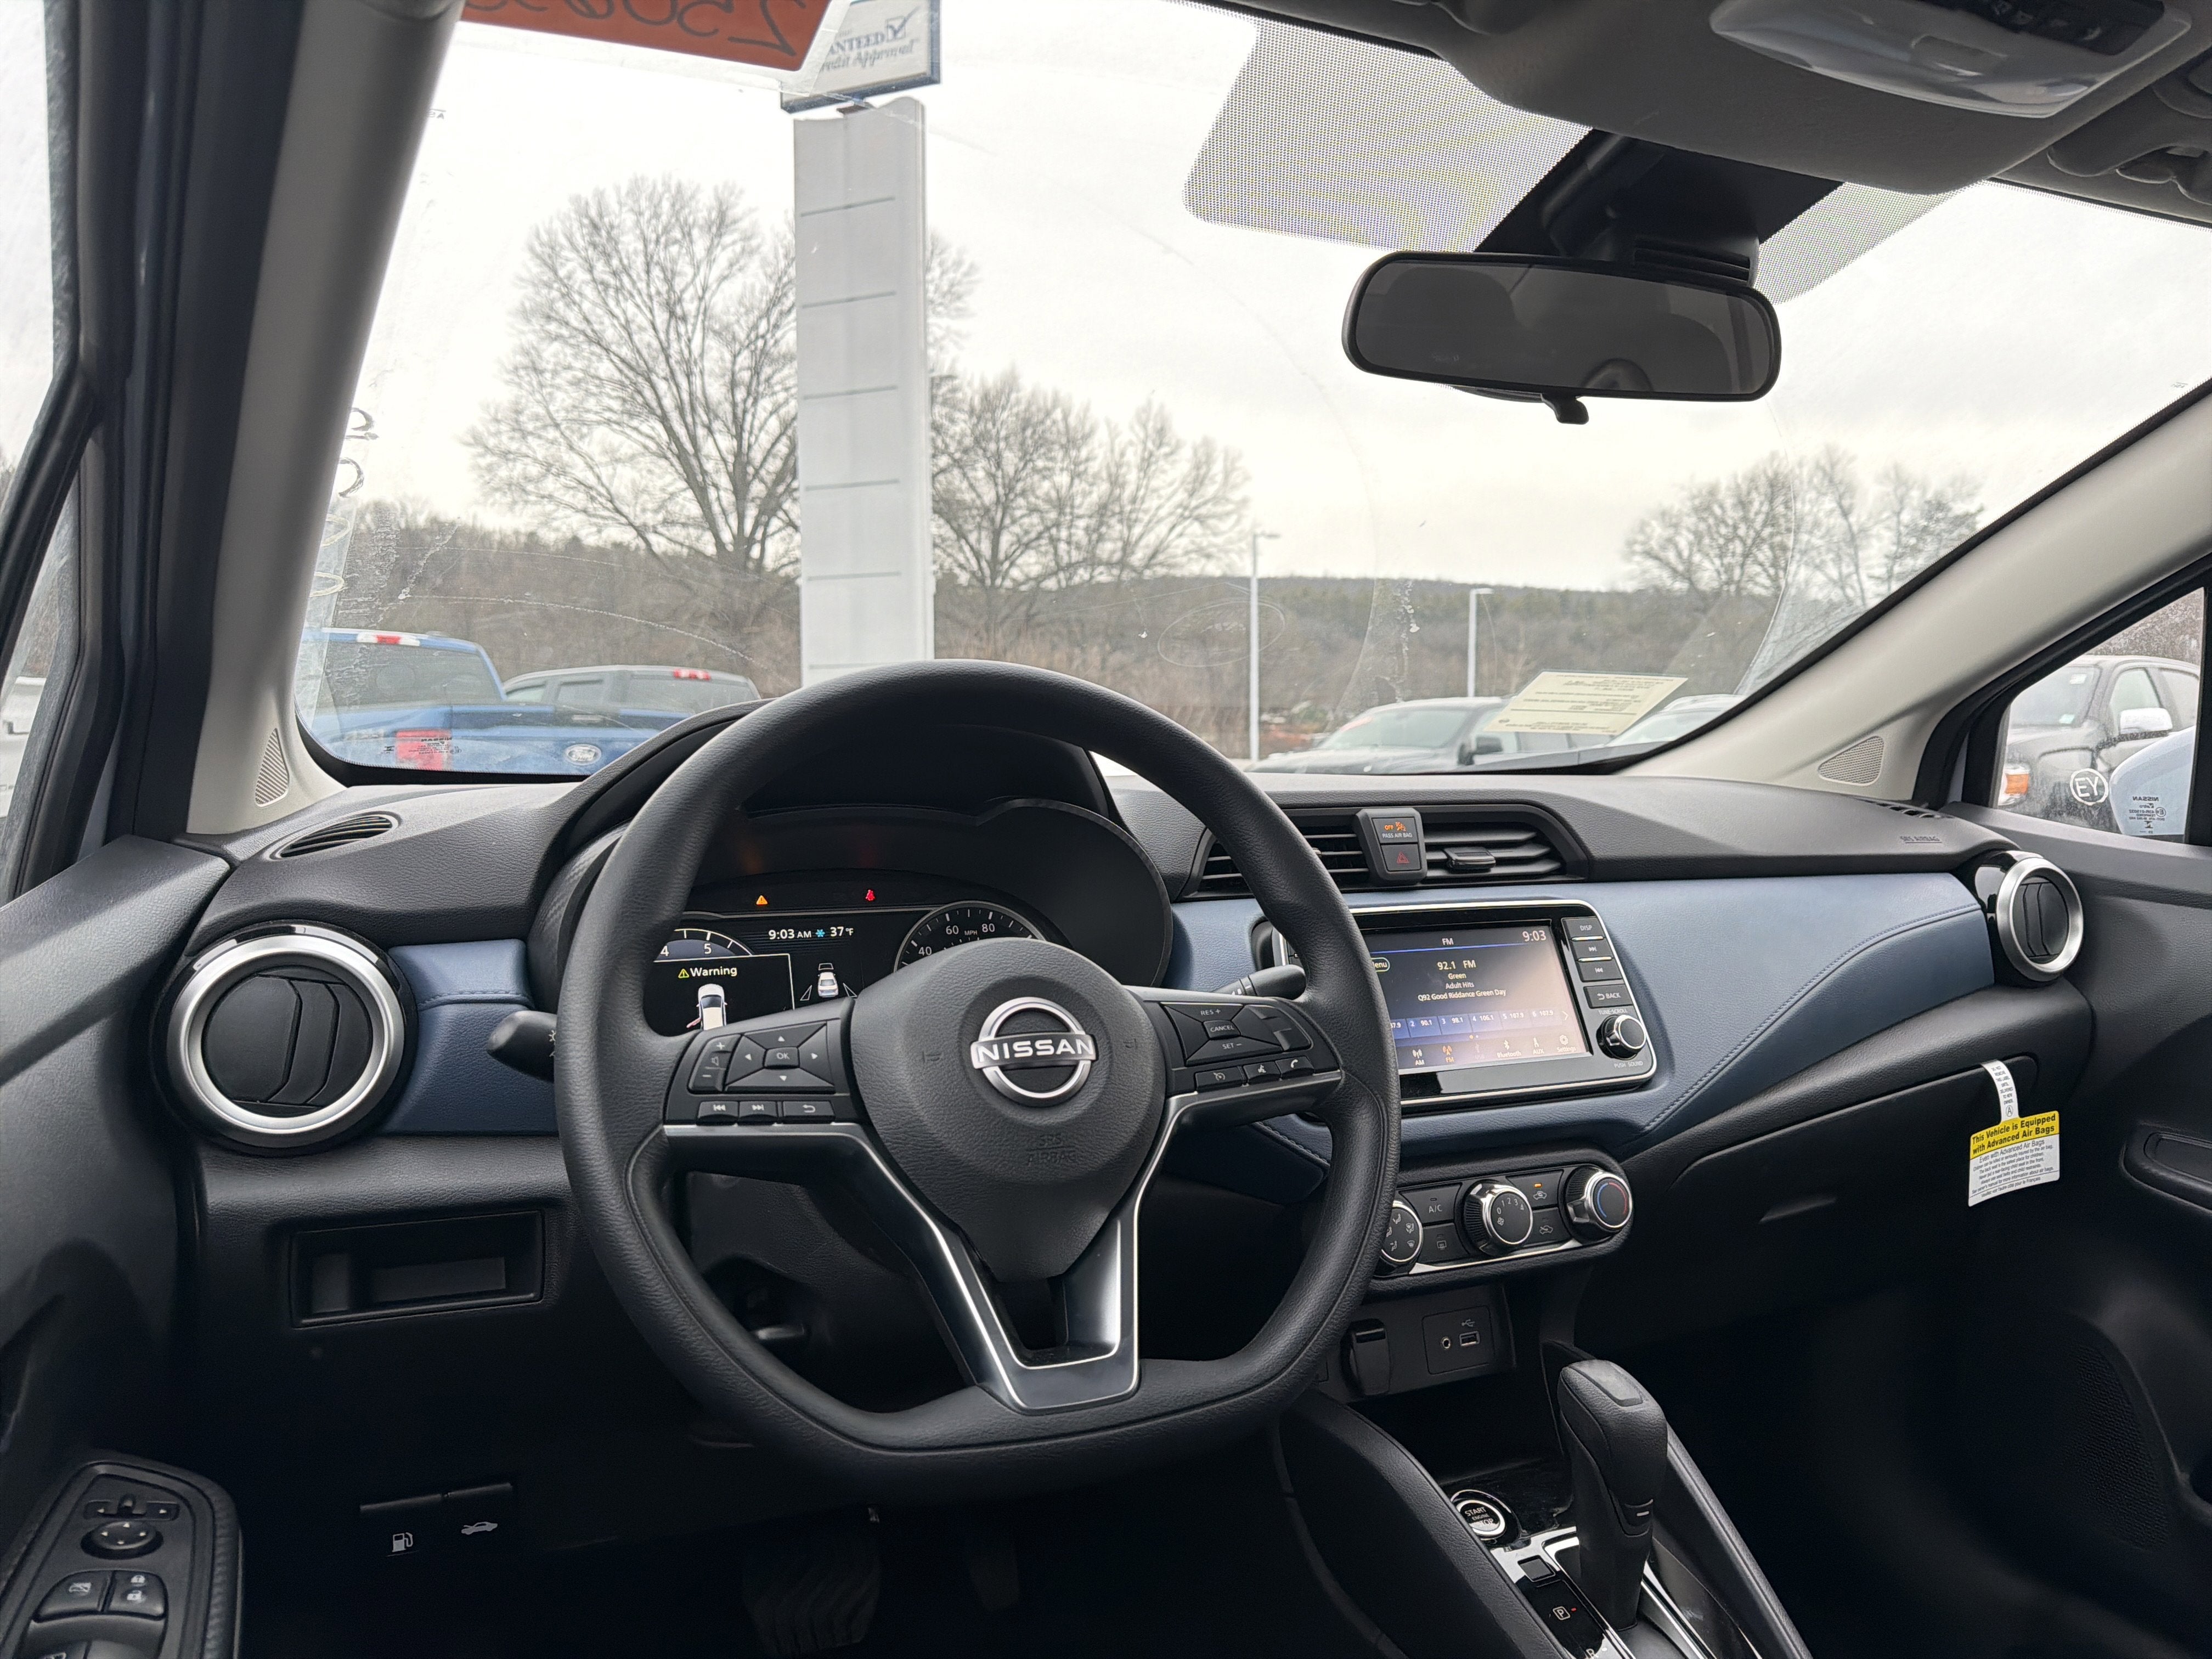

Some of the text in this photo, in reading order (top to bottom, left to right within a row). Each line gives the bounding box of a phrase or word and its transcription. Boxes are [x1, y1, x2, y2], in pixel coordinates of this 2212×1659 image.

[946, 926, 959, 935] 60
[981, 923, 995, 933] 80
[768, 929, 795, 940] 9:03
[1522, 930, 1547, 942] 9:03
[659, 945, 669, 956] 4
[704, 943, 712, 954] 5
[918, 946, 932, 956] 40
[1437, 960, 1476, 970] 92.1 FM
[690, 966, 737, 977] Warning
[1418, 994, 1431, 1002] Q92
[1448, 990, 1475, 999] Riddance
[1494, 988, 1506, 997] Day
[776, 1052, 791, 1060] OK
[978, 1039, 1093, 1062] NISSAN
[1497, 1050, 1522, 1058] Bluetooth
[1973, 1113, 2056, 1146] This Vehicle is Equipped
[1972, 1126, 2055, 1155] with Advanced Air Bags
[2000, 1145, 2022, 1155] Advanced
[1429, 1203, 1443, 1214] A/C
[1465, 1507, 1487, 1516] START
